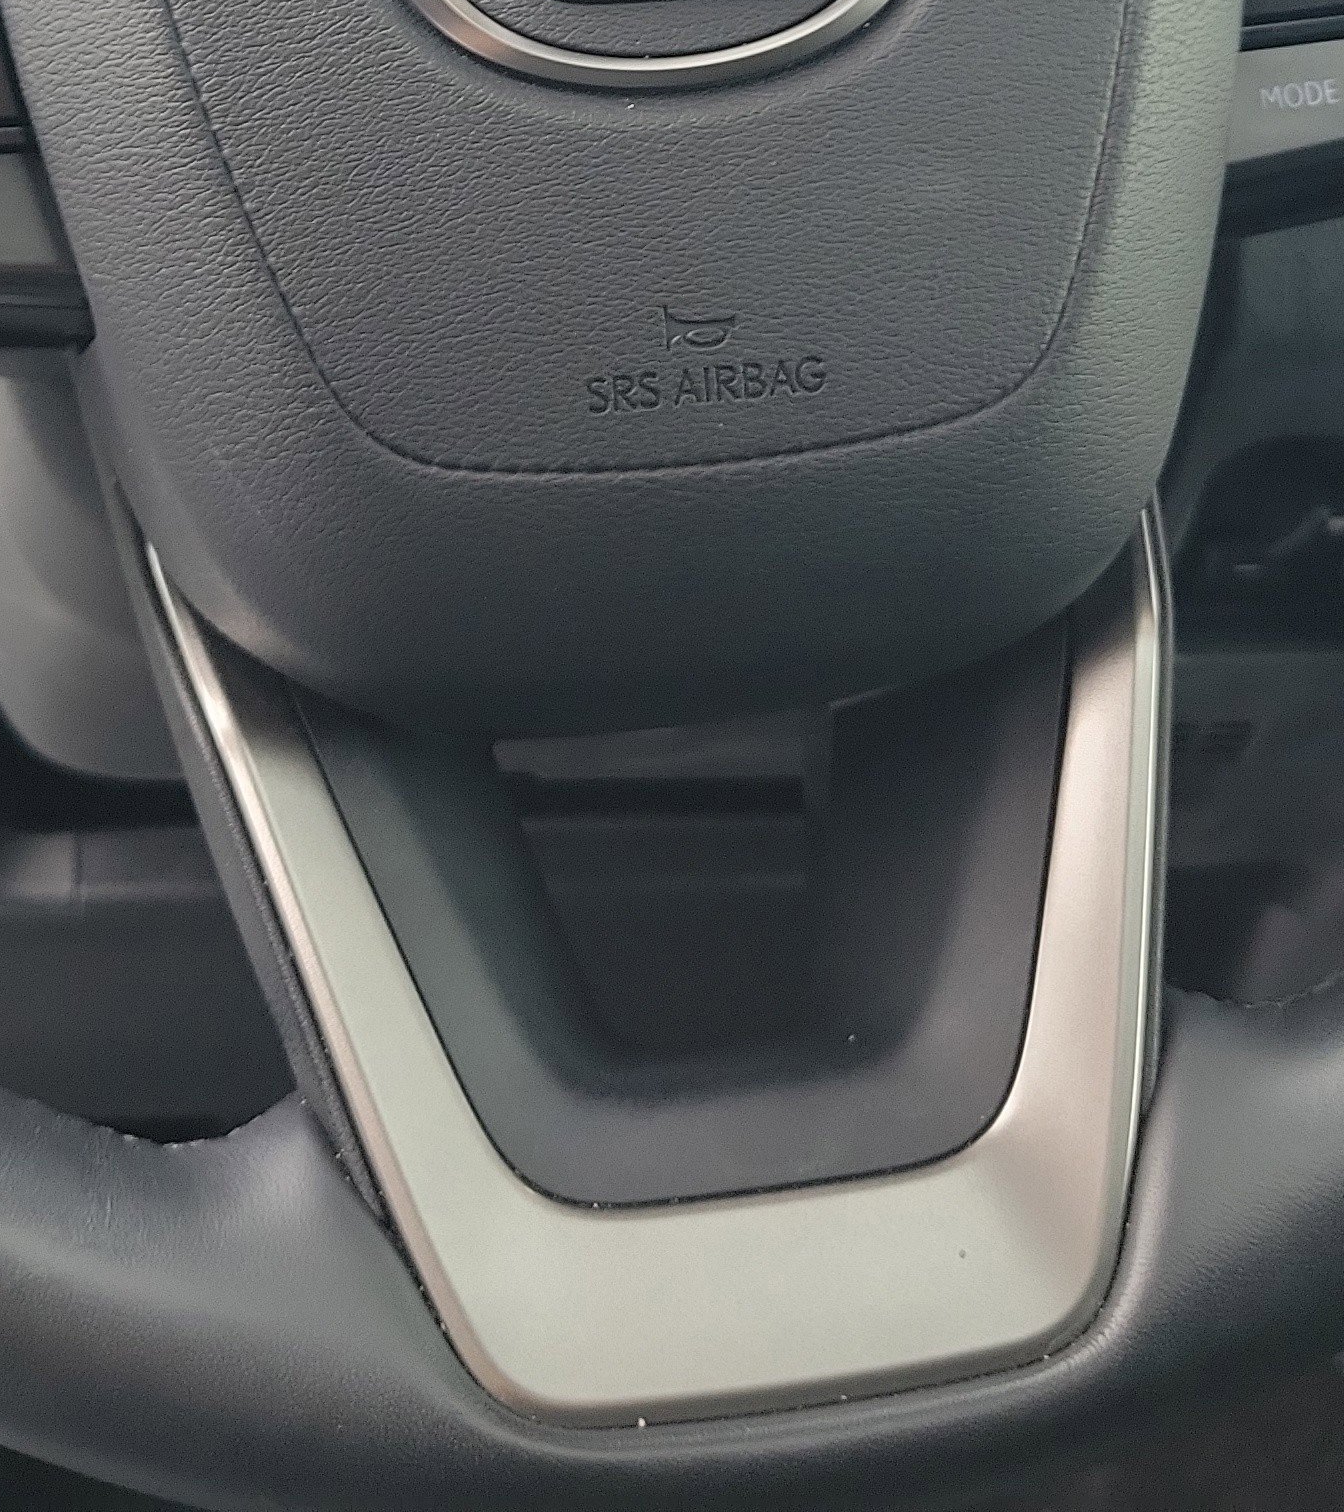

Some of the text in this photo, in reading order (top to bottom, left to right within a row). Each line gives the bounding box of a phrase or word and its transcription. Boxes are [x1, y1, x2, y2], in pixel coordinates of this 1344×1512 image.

[1259, 78, 1339, 109] MODE
[587, 354, 828, 416] SRS AIRBAG
